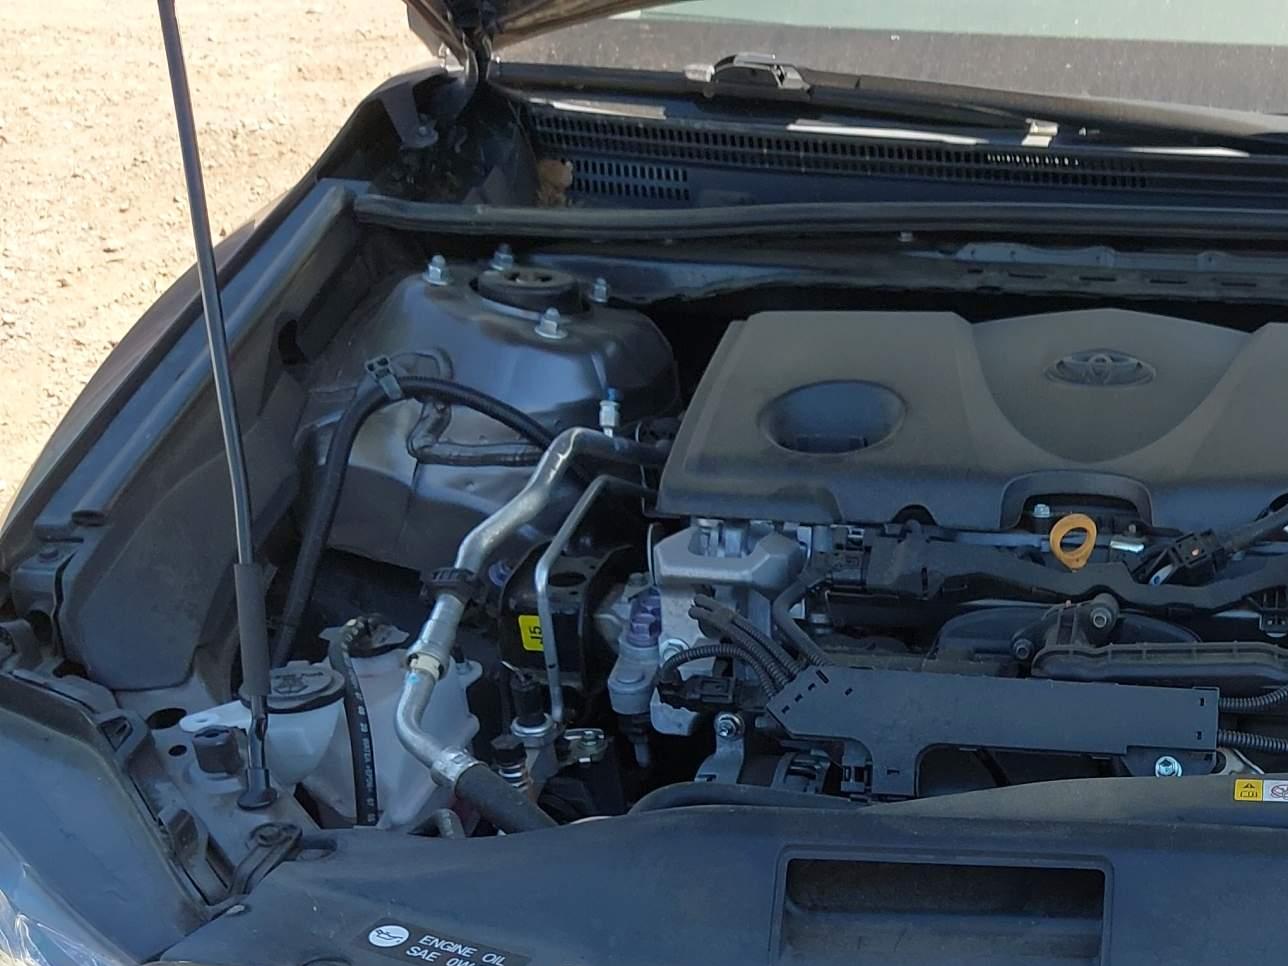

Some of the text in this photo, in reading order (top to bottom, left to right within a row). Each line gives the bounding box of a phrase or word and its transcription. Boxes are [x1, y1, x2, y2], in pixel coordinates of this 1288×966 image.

[406, 946, 441, 963] SAE
[419, 935, 507, 966] ENGINE OIL
